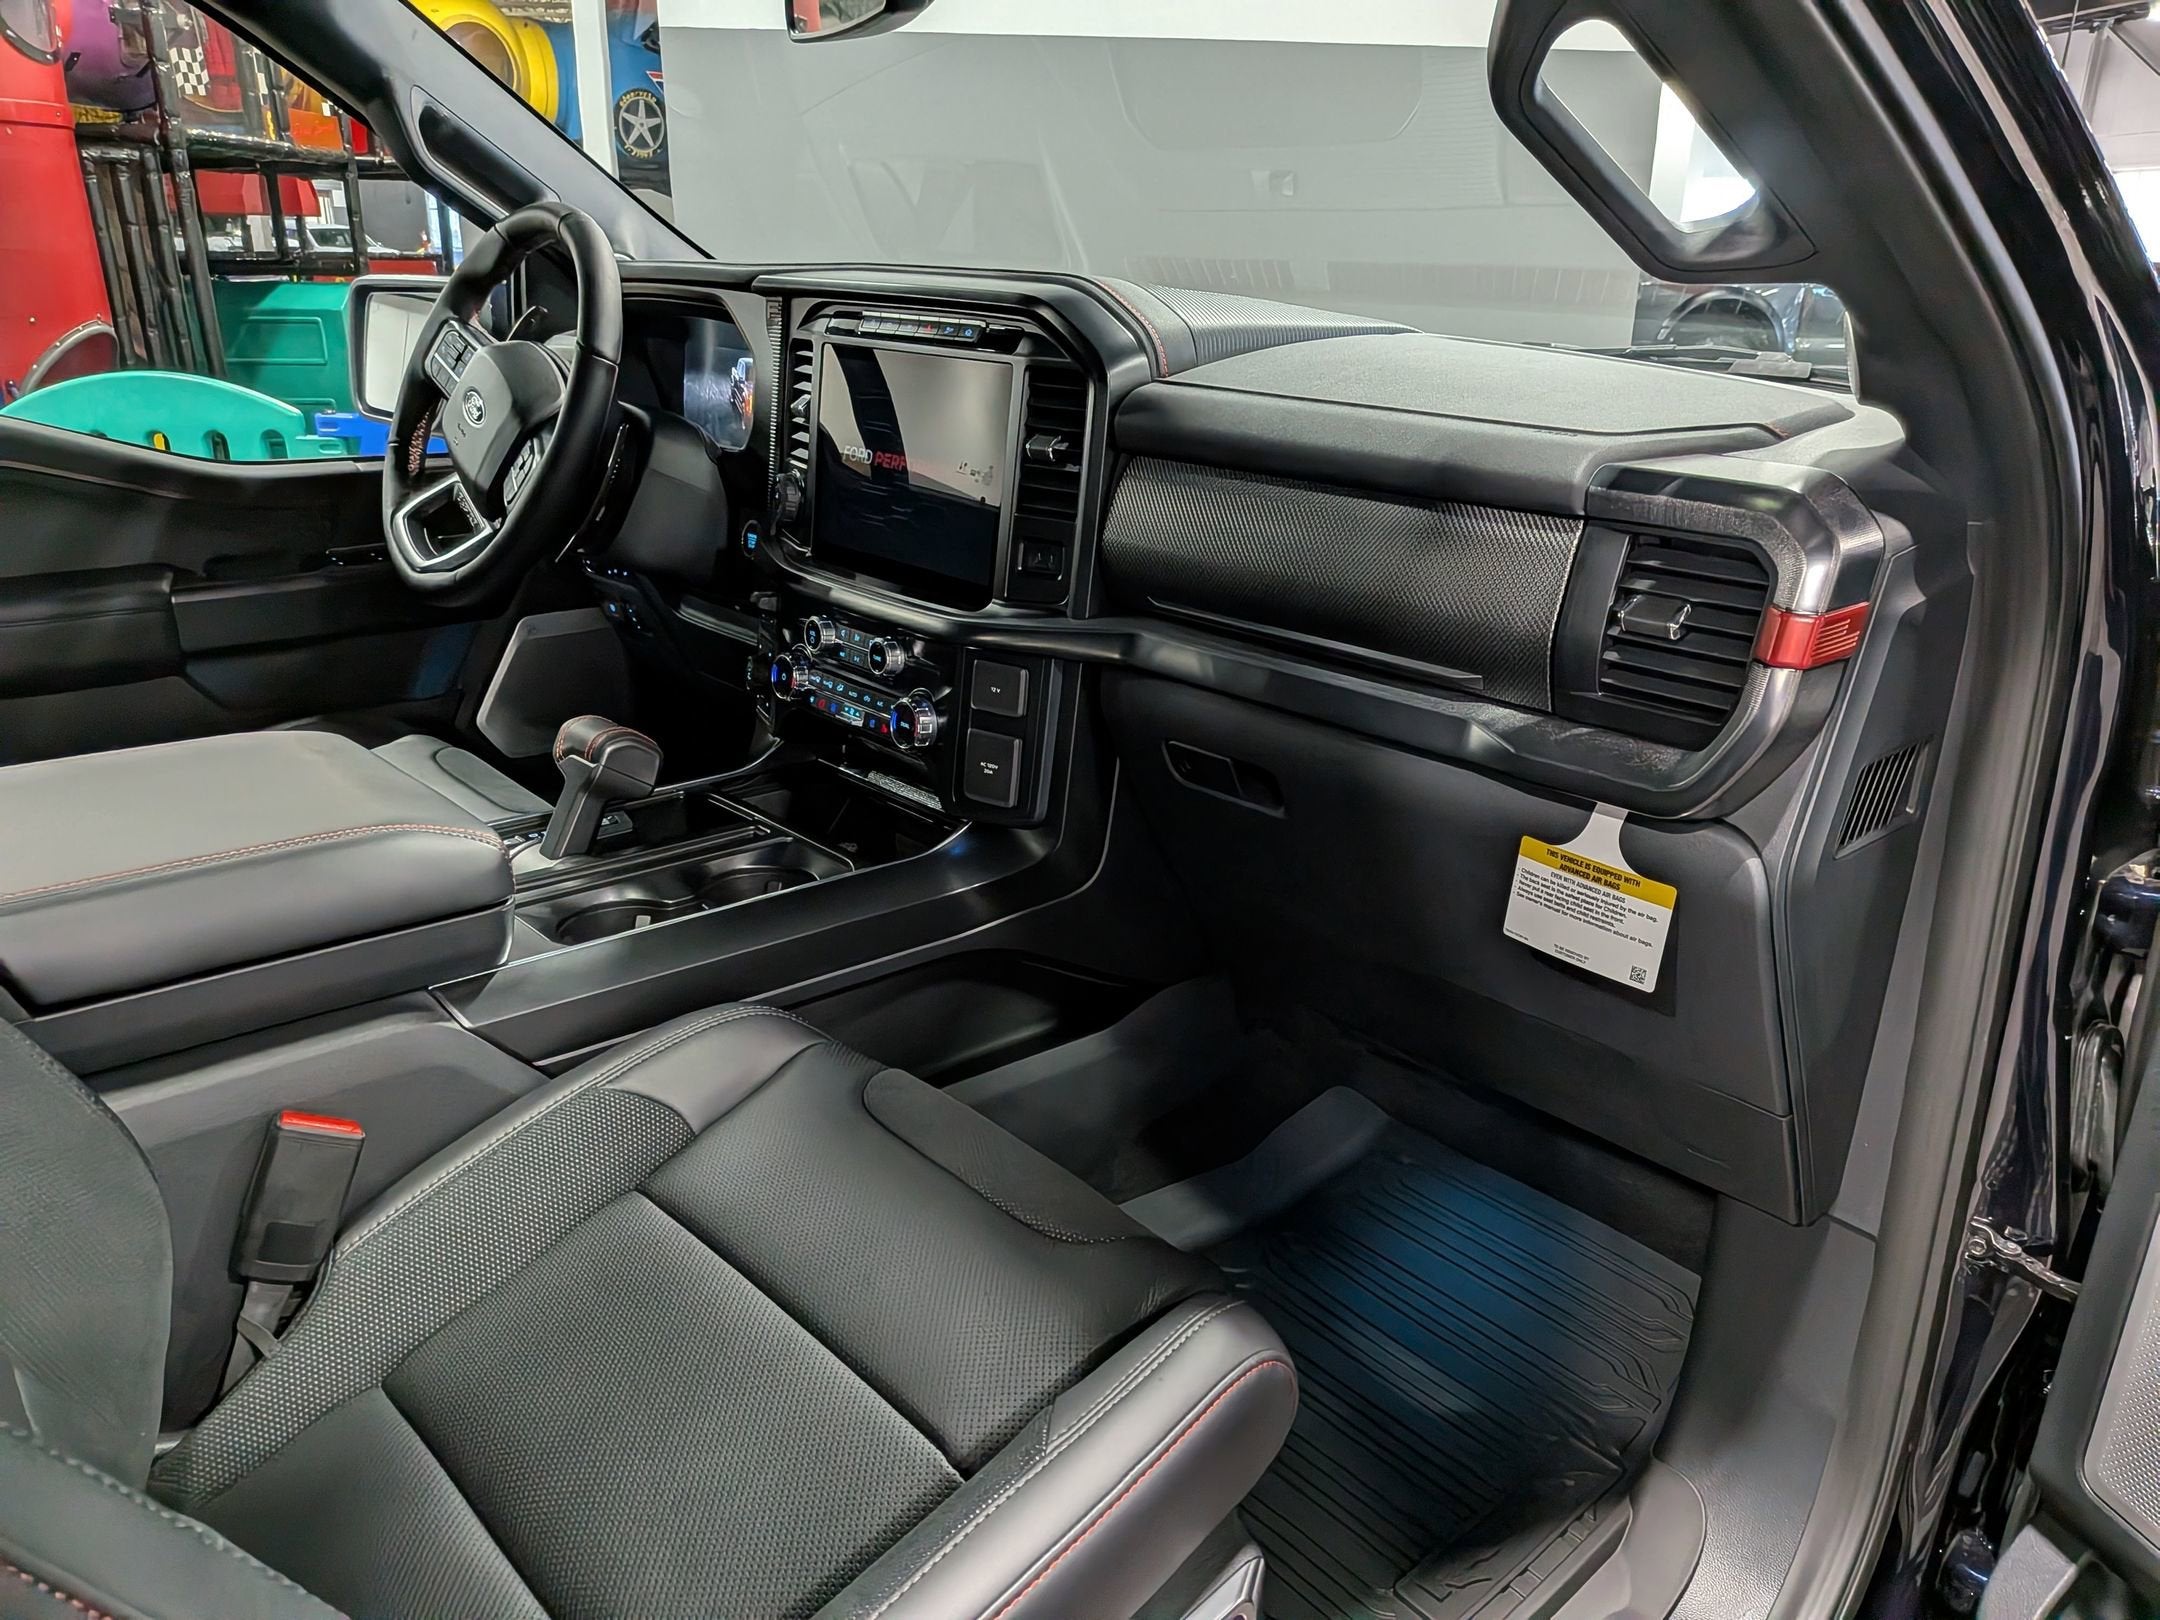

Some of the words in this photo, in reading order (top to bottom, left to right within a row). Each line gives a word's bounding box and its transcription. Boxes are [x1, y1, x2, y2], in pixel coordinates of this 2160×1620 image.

[843, 445, 873, 465] FORD
[1546, 848, 1559, 858] THIS
[1559, 853, 1584, 867] VEHICLE
[1584, 862, 1591, 870] IS
[1591, 865, 1622, 881] EQUIPPED
[1622, 875, 1640, 887] WITH
[1559, 863, 1591, 879] ADVANCED
[1591, 874, 1602, 884] AIR
[1603, 878, 1621, 890] BAGS
[1550, 871, 1562, 880] EVEN
[1563, 876, 1575, 885] WITH
[1576, 881, 1601, 894] ADVANCED
[1601, 890, 1611, 898] AIR
[1611, 893, 1626, 903] BAGS
